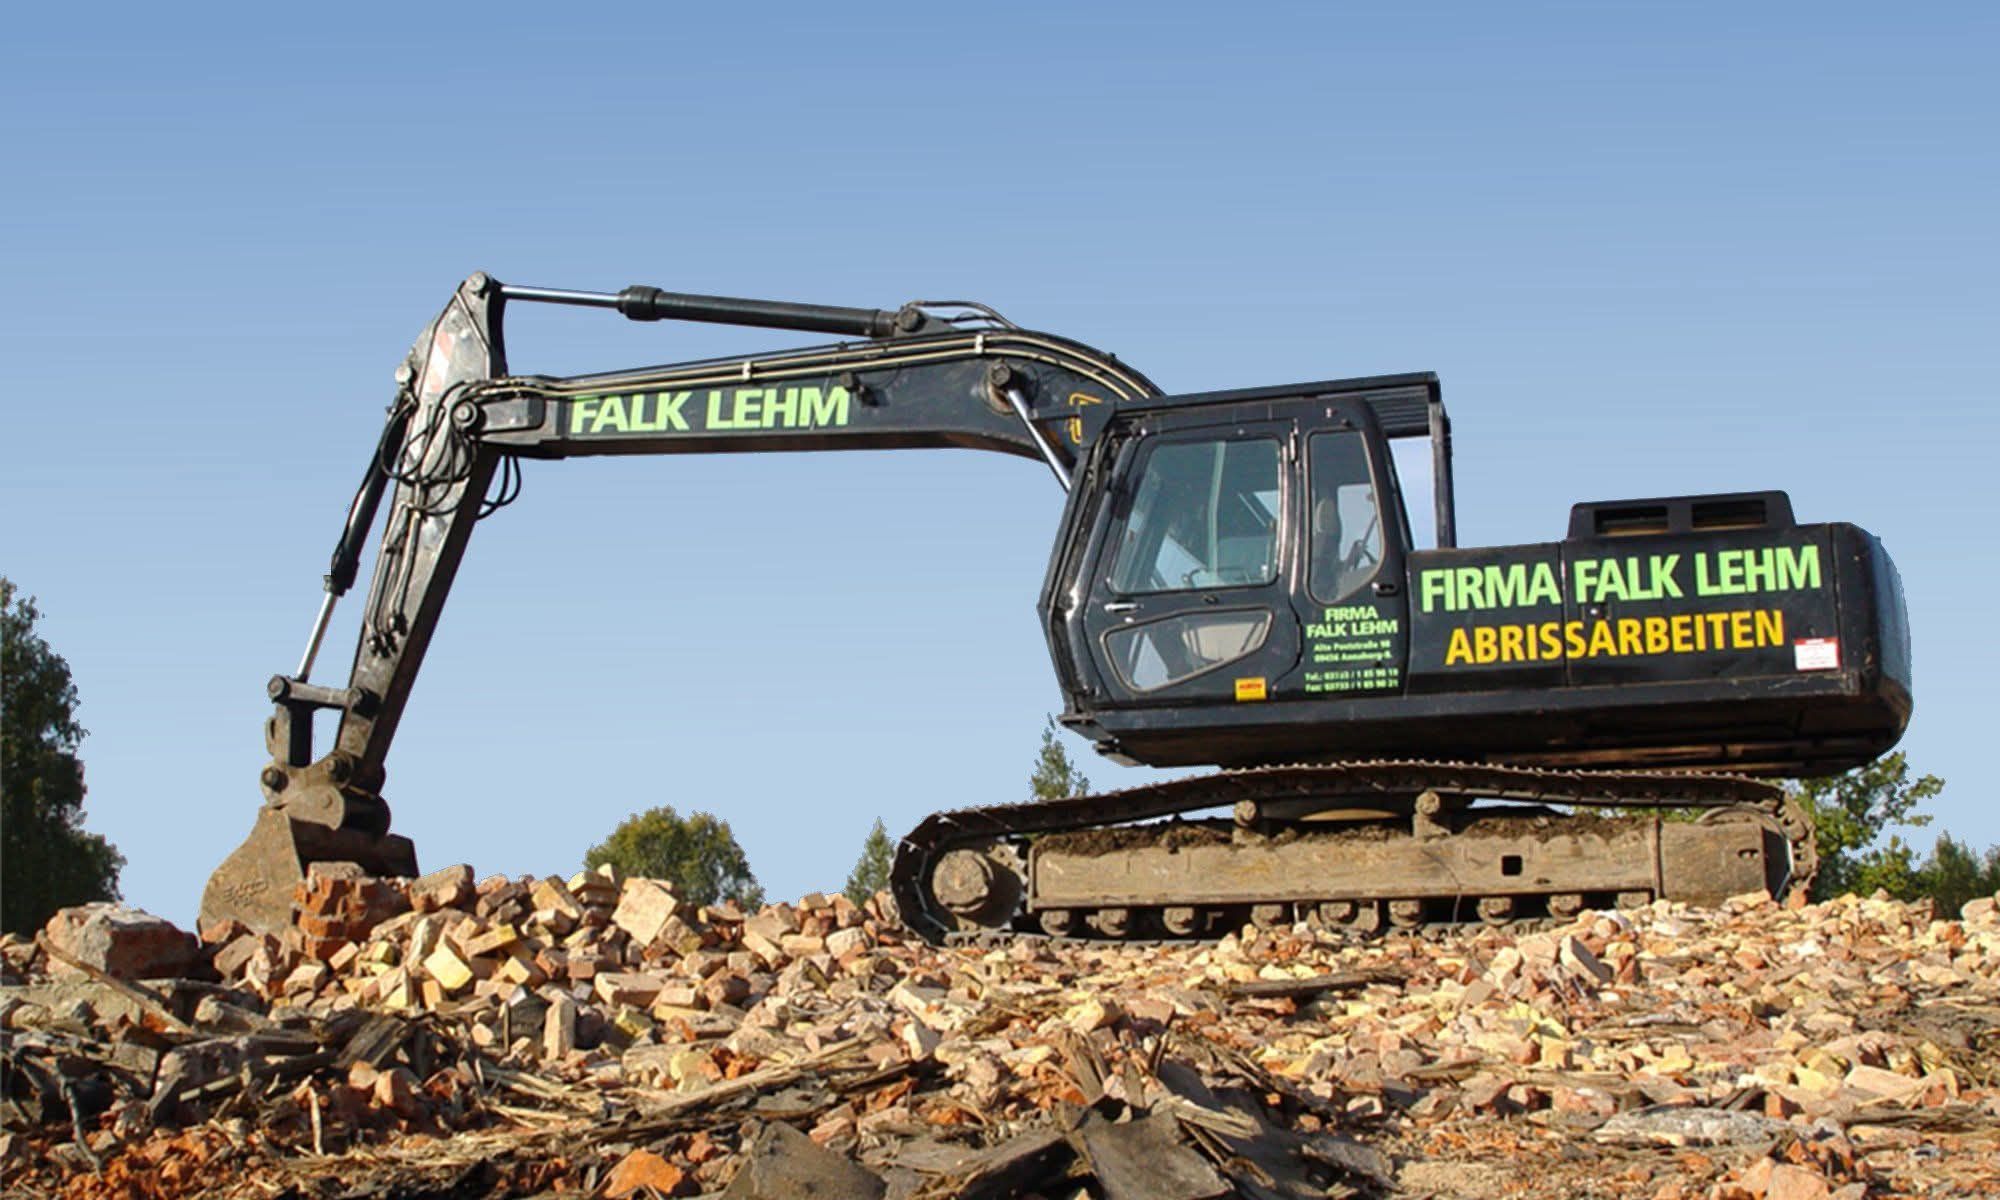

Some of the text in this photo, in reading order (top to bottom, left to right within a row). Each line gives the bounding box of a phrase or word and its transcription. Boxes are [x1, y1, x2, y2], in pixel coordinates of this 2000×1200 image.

[571, 386, 849, 434] FALK LEHM
[1421, 544, 1822, 613] FIRMA FALK LEHM
[1306, 619, 1398, 638] FALK LEHM
[1325, 606, 1378, 622] FIRMA
[1445, 609, 1784, 666] ABRISSARBEITEN
